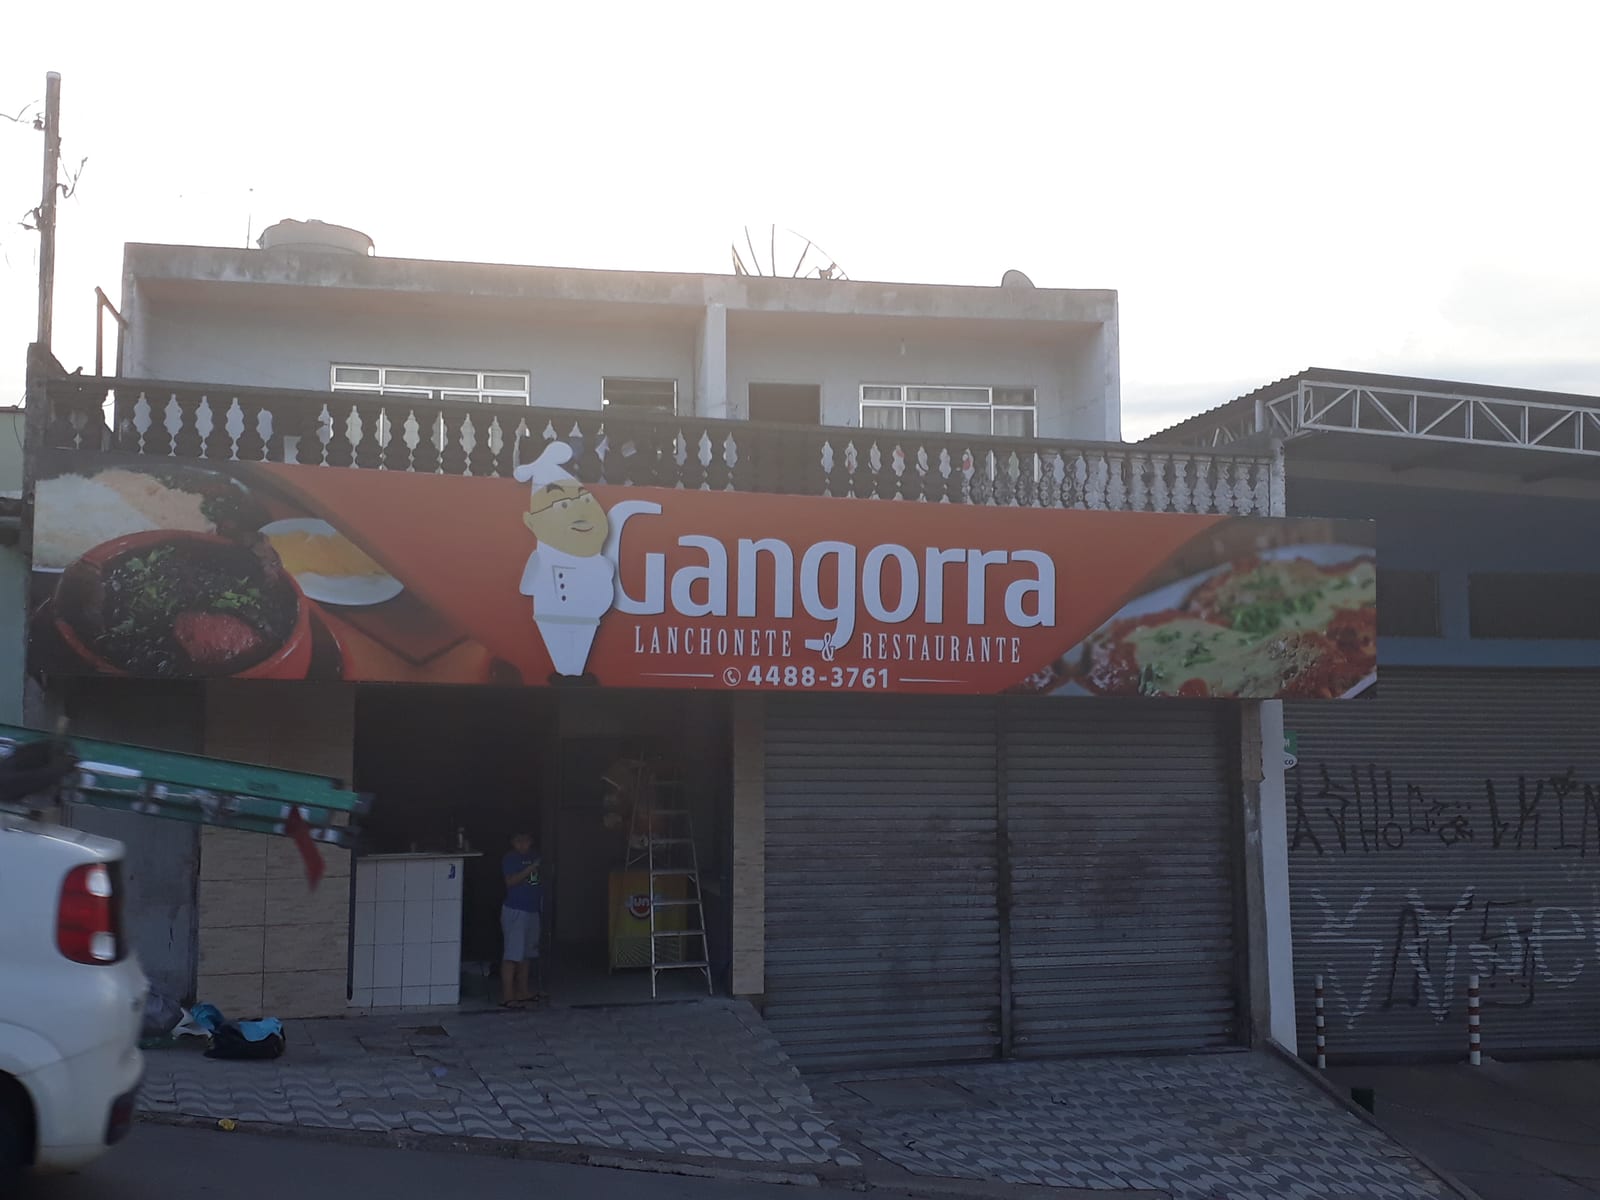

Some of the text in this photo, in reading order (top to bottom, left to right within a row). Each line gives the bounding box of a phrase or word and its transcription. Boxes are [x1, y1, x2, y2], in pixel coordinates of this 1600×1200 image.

[608, 500, 1056, 652] Gangorra
[634, 625, 1022, 664] LANCHONETE & RESTAURANTE
[747, 665, 889, 689] 4488-3761
